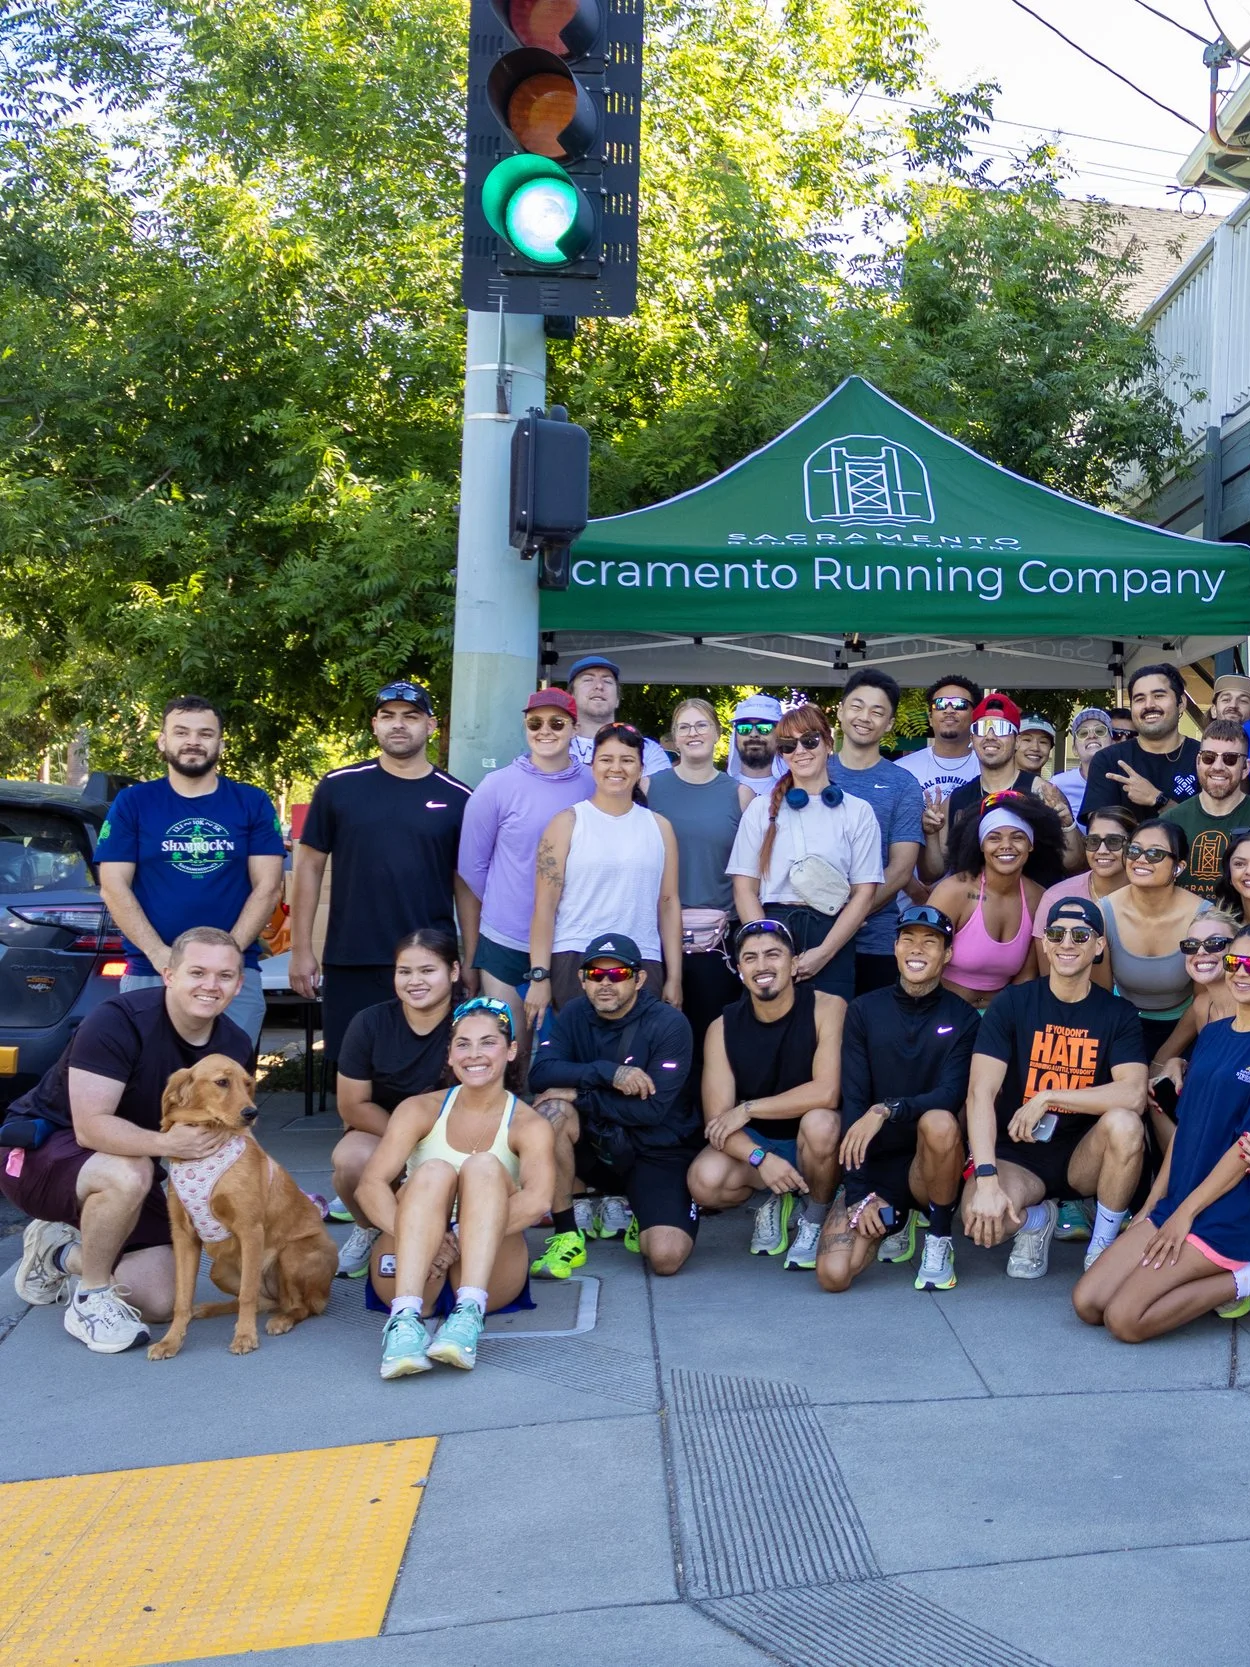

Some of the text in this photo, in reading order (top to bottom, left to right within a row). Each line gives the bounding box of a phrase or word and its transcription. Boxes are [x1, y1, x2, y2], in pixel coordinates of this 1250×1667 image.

[728, 532, 1019, 545] SACRAMENTO
[571, 557, 1226, 602] cramento Running Company
[1046, 1023, 1054, 1033] IF
[1065, 1027, 1089, 1038] DON'T
[1030, 1030, 1099, 1070] HATE
